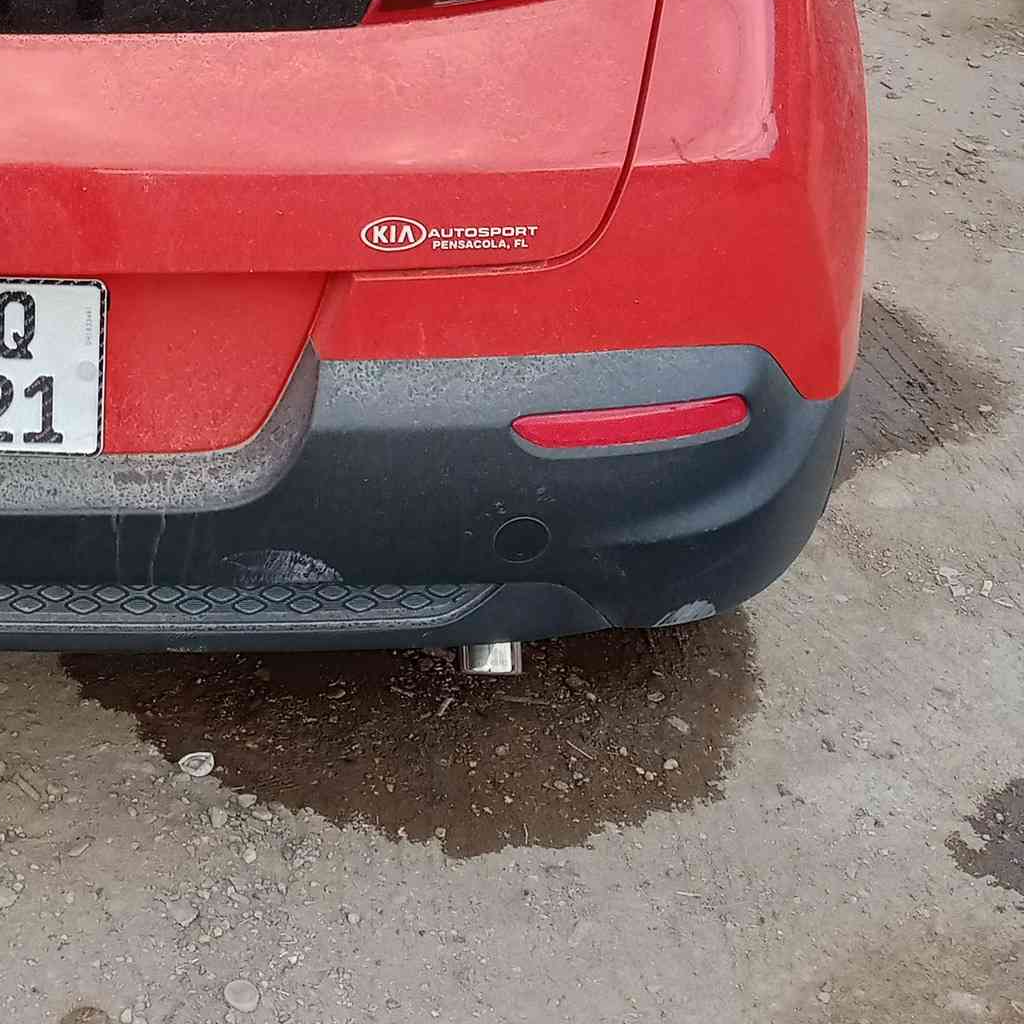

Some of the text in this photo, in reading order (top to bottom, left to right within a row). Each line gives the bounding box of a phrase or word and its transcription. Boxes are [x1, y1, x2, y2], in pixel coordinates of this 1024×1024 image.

[371, 225, 415, 244] KIA
[427, 226, 538, 239] AUTOSPORT
[432, 238, 529, 250] PENSACOLA, FL
